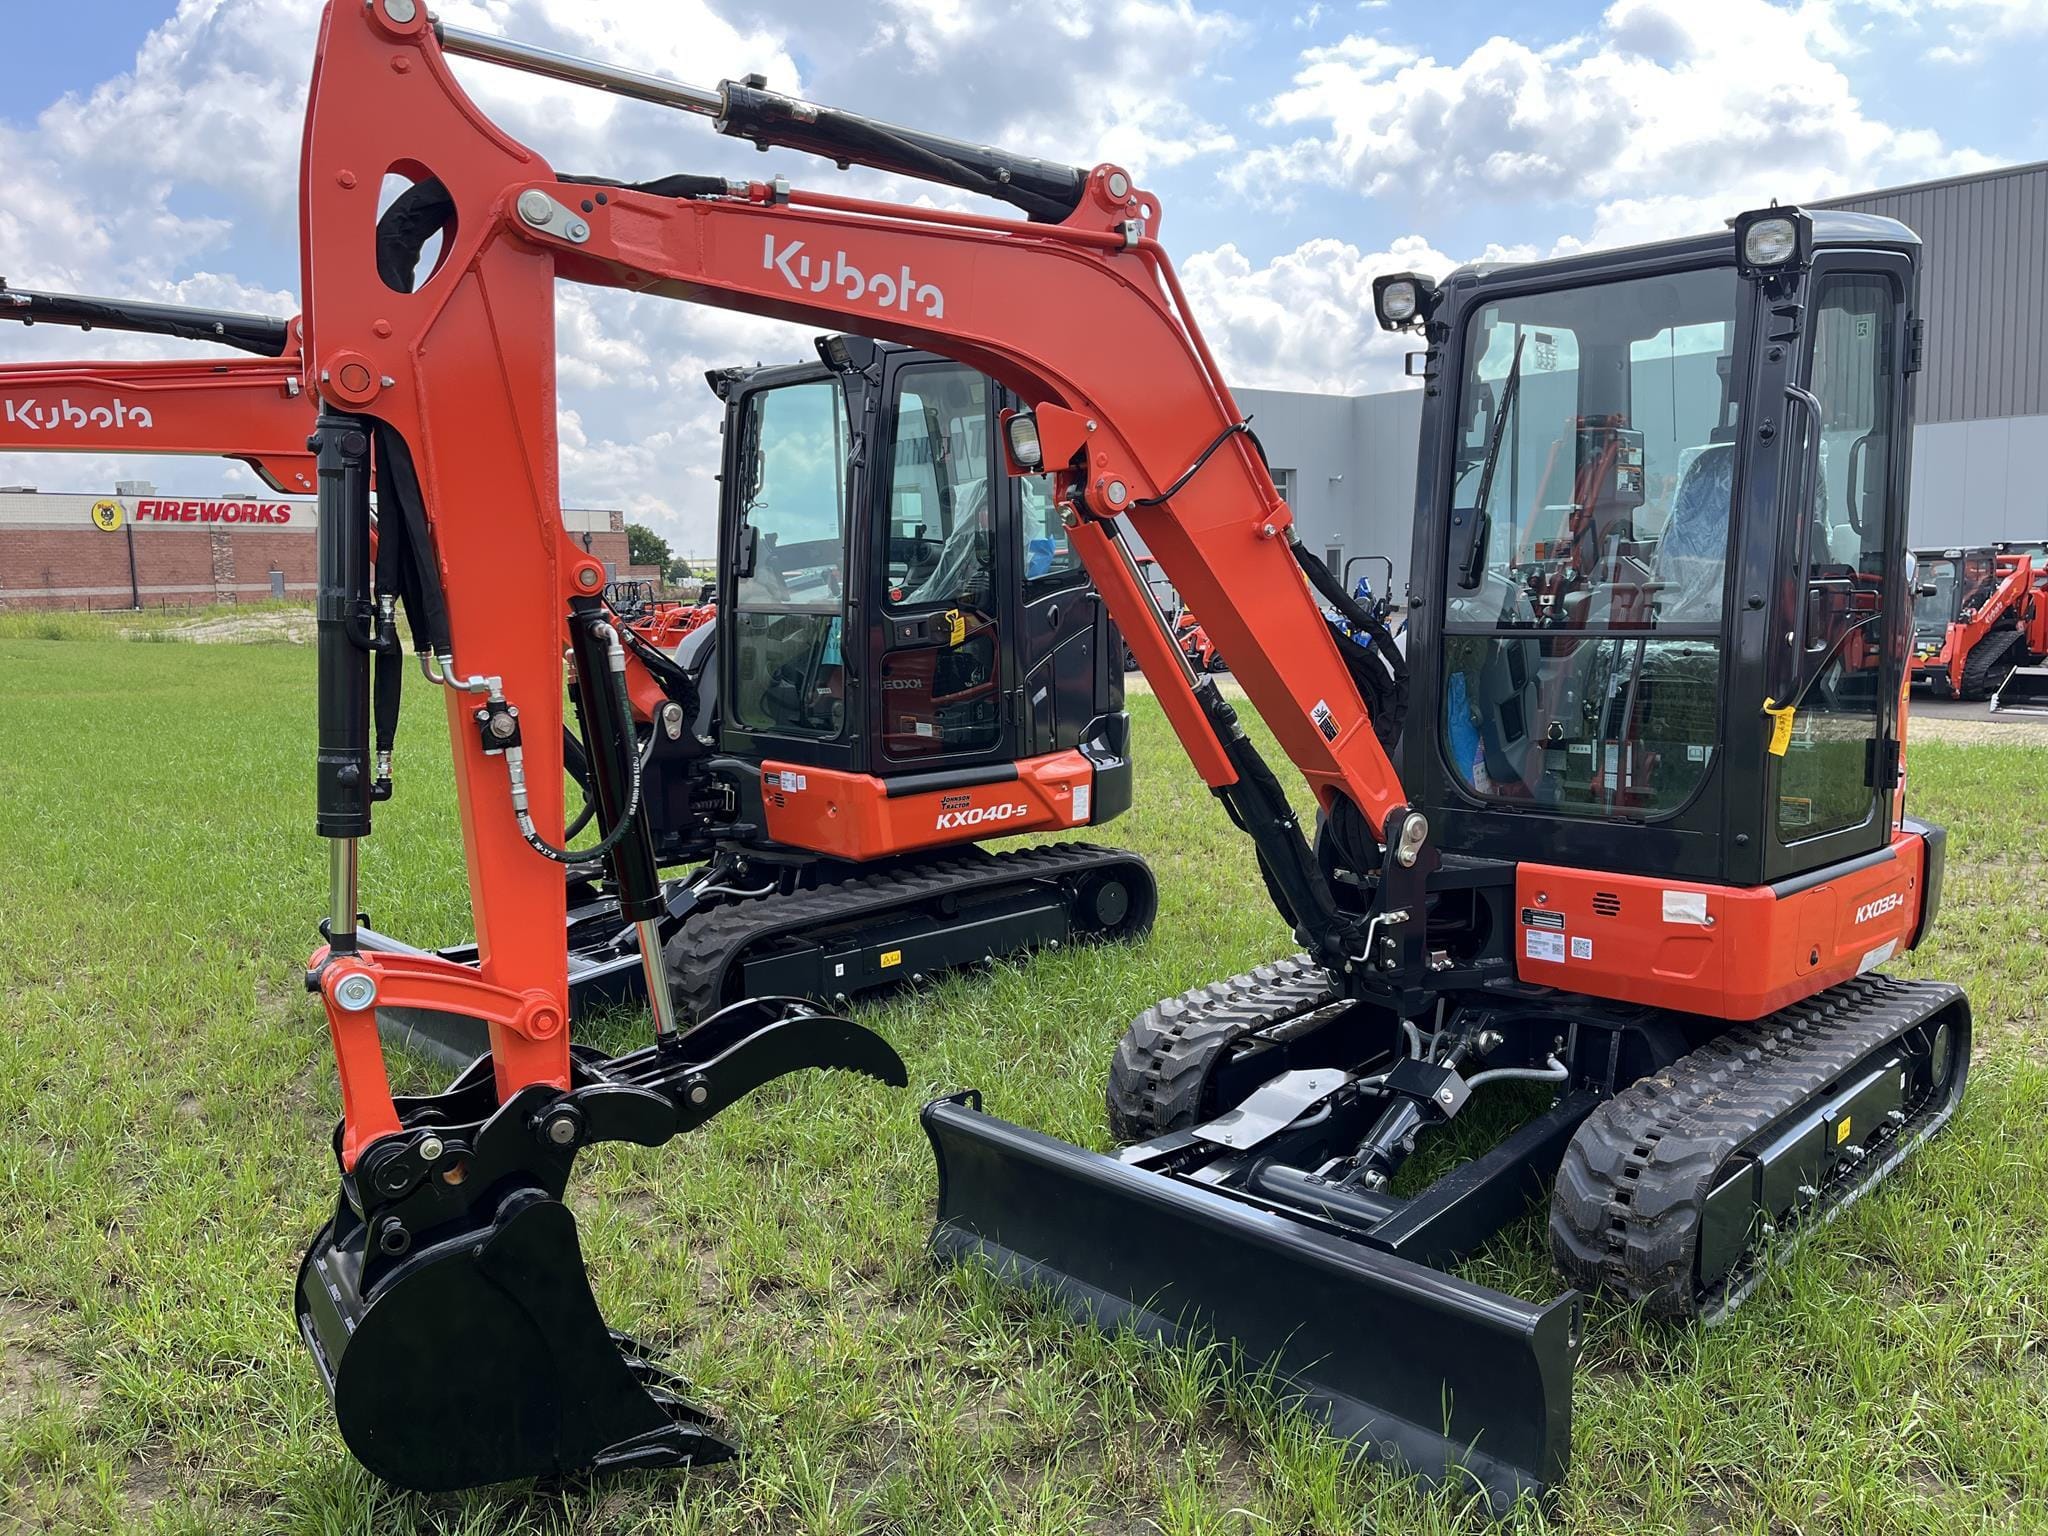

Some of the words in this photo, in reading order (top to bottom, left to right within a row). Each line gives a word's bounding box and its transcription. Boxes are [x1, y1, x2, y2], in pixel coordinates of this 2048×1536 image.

[763, 234, 944, 318] Kubota
[6, 398, 153, 429] Kubota
[136, 500, 291, 524] FIREWORKS
[941, 795, 970, 804] JOHNSON
[942, 802, 970, 810] TRACTOR
[1855, 893, 1904, 925] KX033-4
